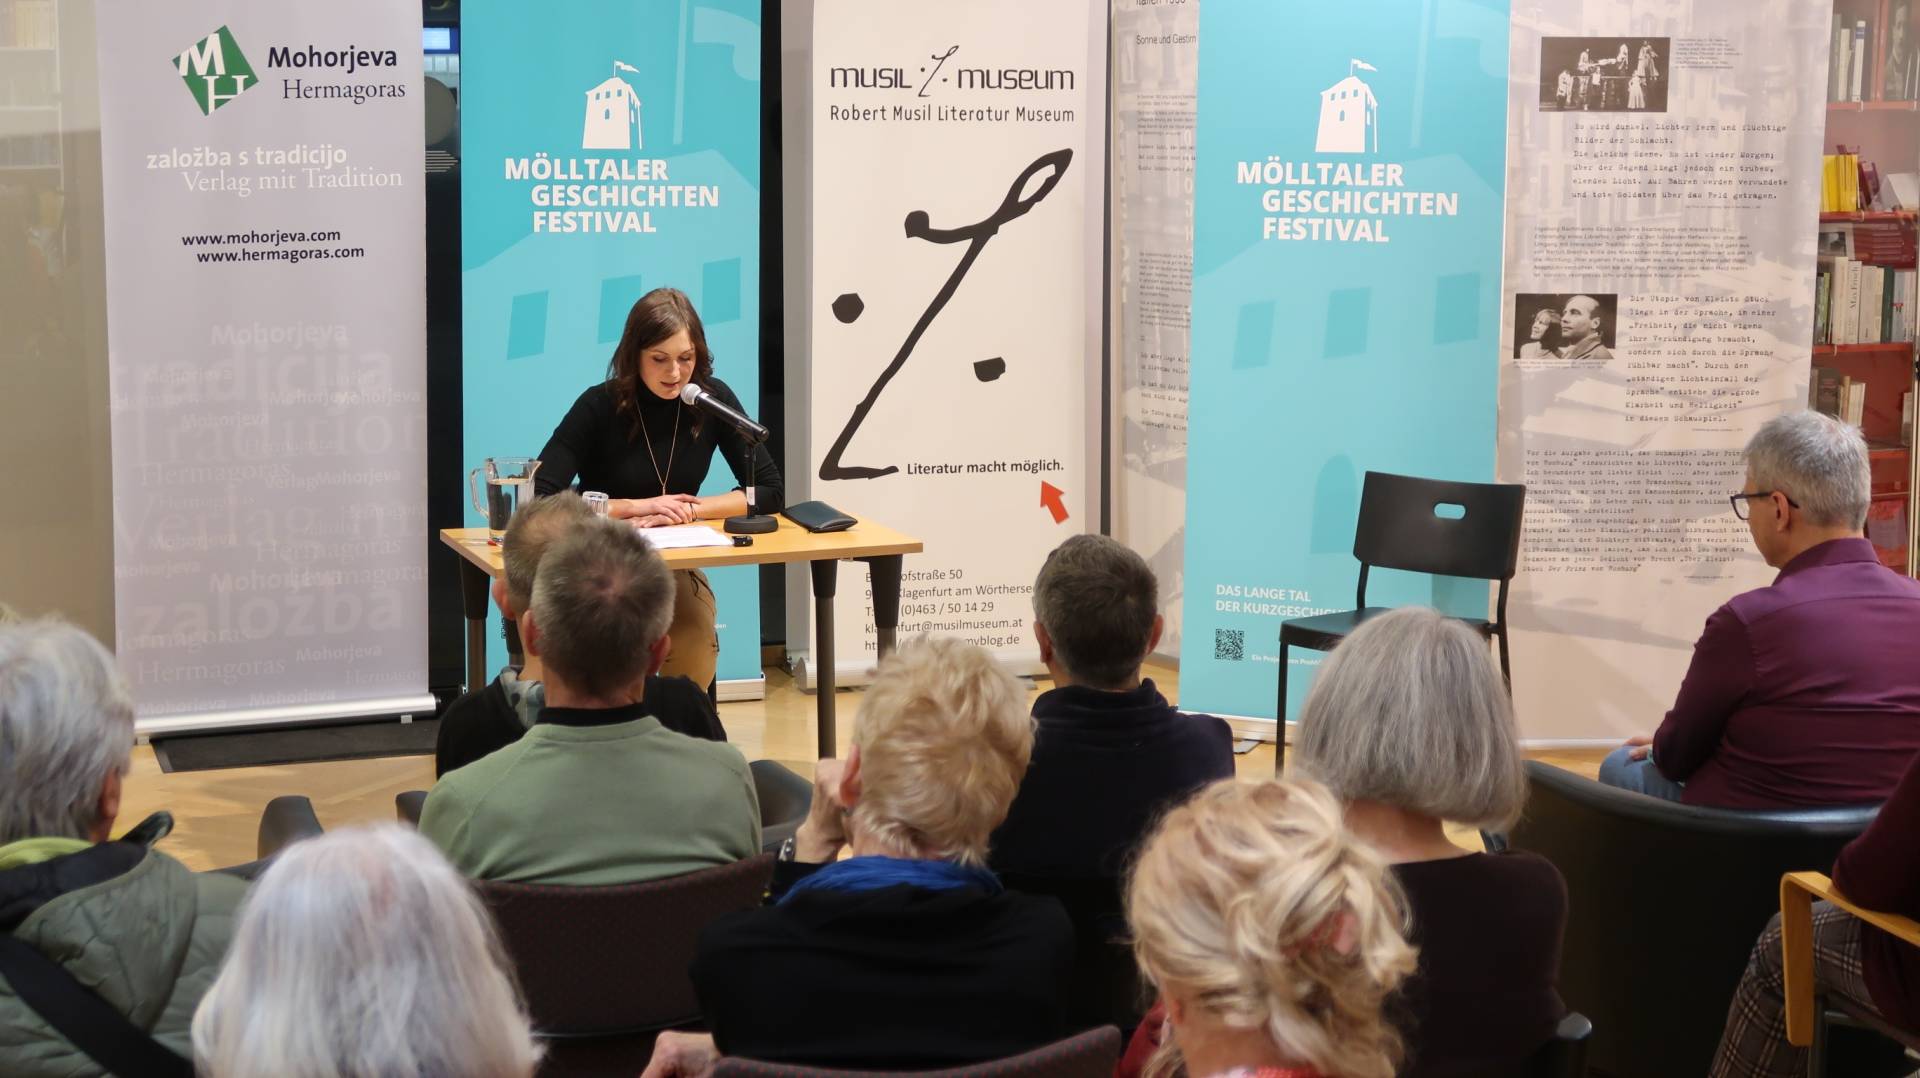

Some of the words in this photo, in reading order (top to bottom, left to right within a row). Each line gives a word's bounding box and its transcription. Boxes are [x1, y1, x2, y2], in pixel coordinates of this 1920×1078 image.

[1136, 34, 1158, 45] Sonne
[1159, 34, 1171, 45] und
[267, 45, 397, 73] Mohorjeva
[957, 68, 1075, 90] museum
[282, 79, 406, 105] Hermagoras
[830, 105, 887, 122] Robert
[893, 105, 931, 122] Musil
[938, 106, 1010, 122] Literatur
[1016, 107, 1075, 122] Museum
[1721, 123, 1736, 131] und
[1575, 136, 1604, 144] Bilder
[1609, 136, 1624, 144] der
[147, 147, 231, 170] založba
[239, 152, 247, 167] s
[255, 144, 347, 169] tradicijo
[1684, 150, 1699, 158] ist
[505, 152, 668, 181] MÖLLTALER
[1237, 155, 1404, 187] MÖLLTALER
[1598, 163, 1613, 171] der
[1618, 163, 1649, 173] Gegend
[1653, 163, 1679, 173] liegt
[1684, 164, 1714, 173] jedoch
[182, 170, 251, 197] Verlag
[259, 170, 296, 189] mit
[302, 167, 403, 189] Tradition
[531, 184, 719, 207] GESCHICHTEN
[1262, 189, 1458, 216] GESCHICHTEN
[1572, 190, 1587, 198] und
[1592, 190, 1612, 198] tote
[1617, 190, 1657, 198] Soldaten
[1662, 190, 1682, 198] über
[533, 211, 656, 233] FESTIVAL
[1263, 217, 1389, 242] FESTIVAL
[182, 230, 341, 247] www.mohorjeva.com
[197, 246, 364, 263] www.hermagoras.com
[1650, 295, 1680, 304] Utopie
[1659, 308, 1669, 316] in
[1674, 308, 1688, 316] der
[1683, 321, 1698, 329] die
[1629, 334, 1648, 342] ihre
[907, 463, 964, 475] Literatur
[966, 461, 1007, 474] macht
[1010, 459, 1064, 475] möglich.
[865, 569, 946, 582] Bofstraße
[949, 569, 963, 580] 50
[899, 586, 952, 600] lagenfurt
[955, 588, 972, 596] am
[976, 584, 1035, 595] Wörtherse
[1216, 584, 1241, 597] DAS
[1244, 586, 1285, 601] LANGE
[1288, 589, 1311, 602] TAL
[901, 604, 936, 617] (0)463
[948, 603, 961, 613] 50
[965, 602, 978, 613] 14
[981, 602, 994, 612] 29
[1216, 600, 1241, 613] DER
[1243, 602, 1348, 618] KURZGESCHI
[865, 618, 1022, 634] klnfurt@musilmuseum.at
